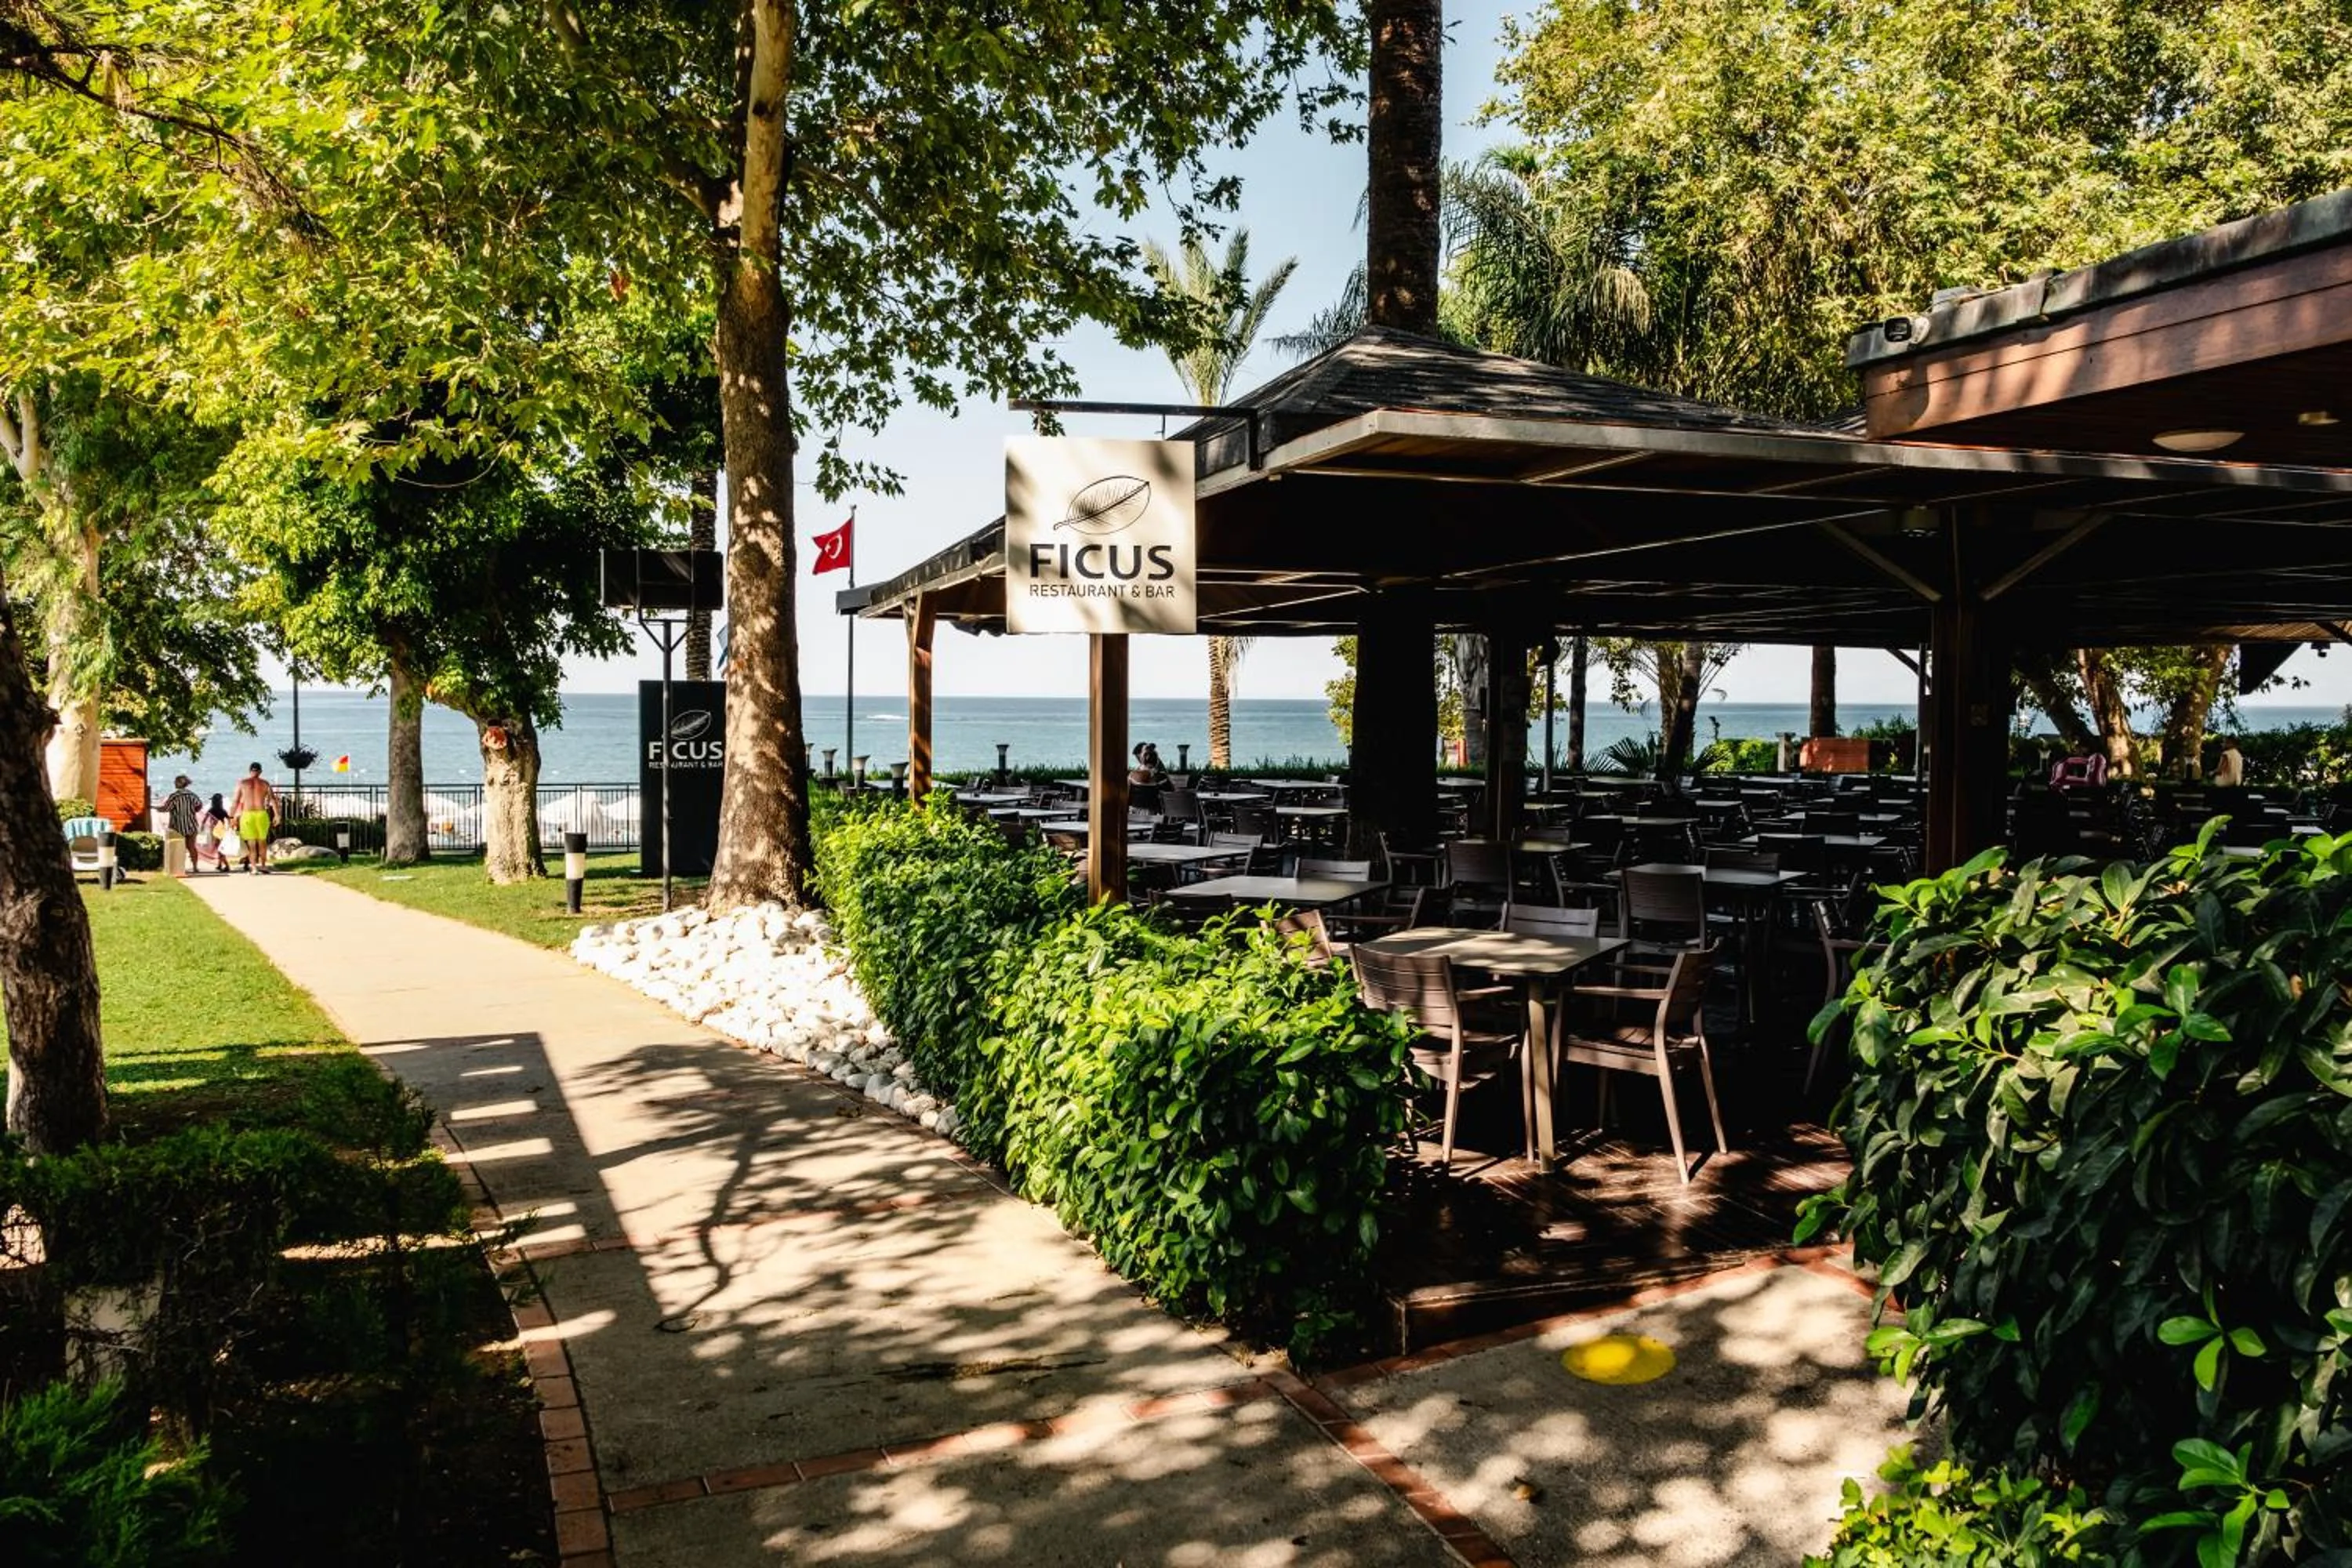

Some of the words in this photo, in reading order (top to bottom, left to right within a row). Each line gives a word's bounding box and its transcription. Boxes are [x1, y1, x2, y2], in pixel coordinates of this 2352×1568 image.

[1030, 544, 1174, 580] FICUS
[1030, 585, 1126, 597] RESTAURANT
[1131, 586, 1140, 597] &
[1145, 586, 1174, 598] BAR
[648, 741, 723, 760] FCUS
